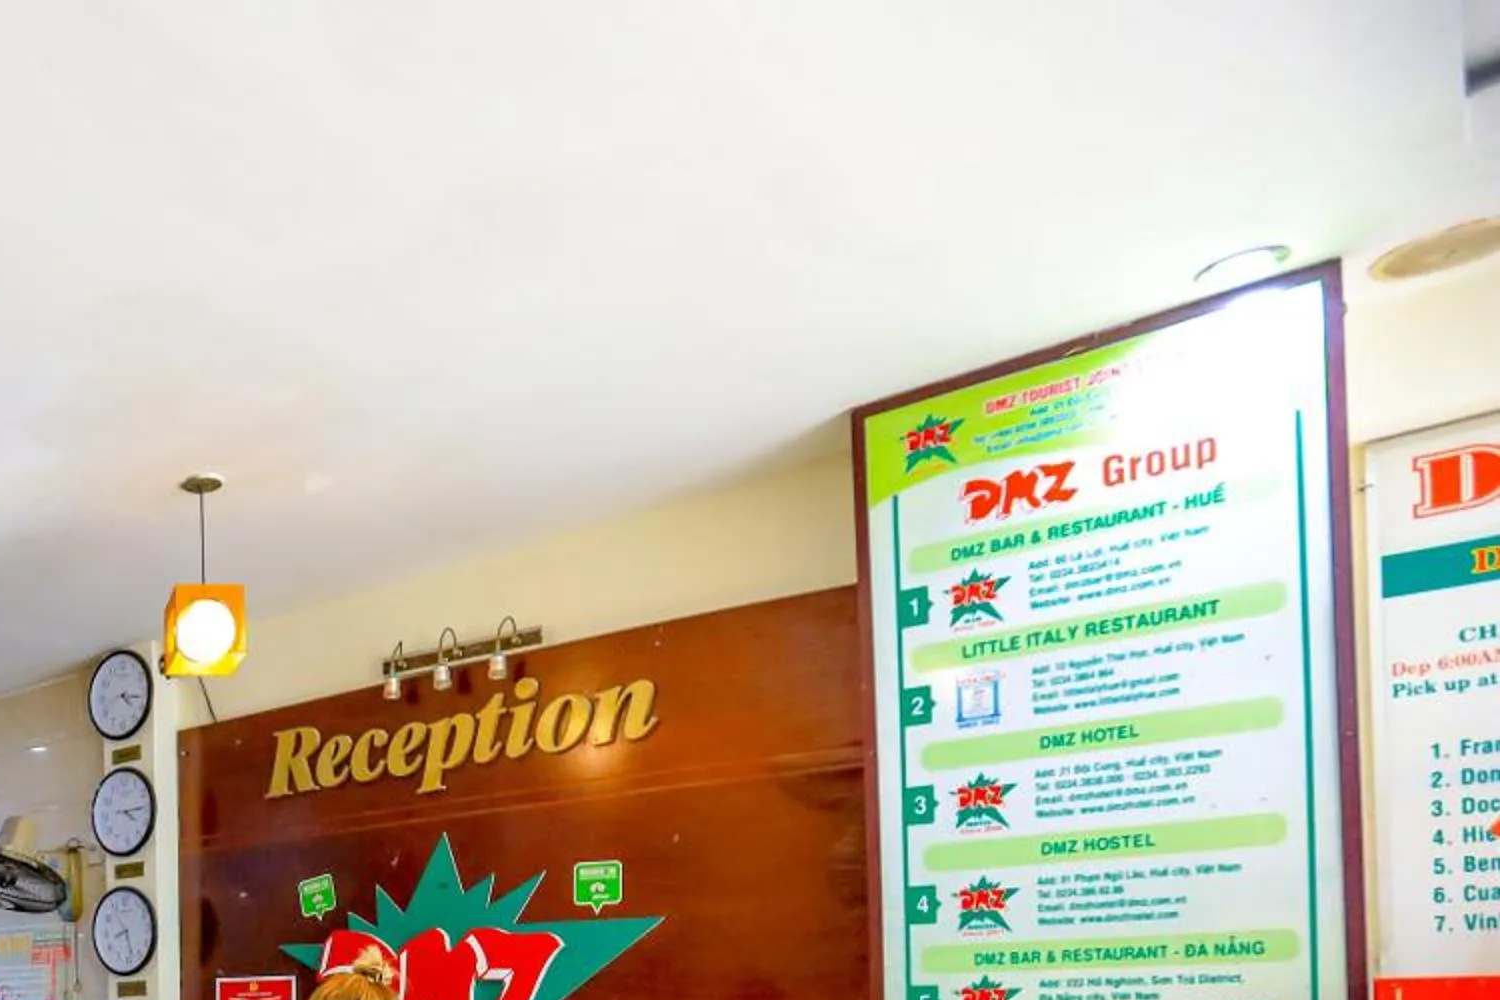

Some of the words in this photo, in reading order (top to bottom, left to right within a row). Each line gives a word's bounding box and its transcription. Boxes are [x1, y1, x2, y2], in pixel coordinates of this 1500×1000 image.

[907, 421, 950, 451] DMZ
[963, 460, 1079, 521] DMZ
[1102, 437, 1217, 488] Group
[951, 542, 984, 562] DMZ
[990, 532, 1024, 552] BAR
[1031, 529, 1041, 543] &
[1048, 501, 1165, 540] RESTAURANT
[951, 578, 996, 607] DMZ
[908, 598, 920, 618] 1
[962, 635, 1020, 660] LITTLE
[1027, 625, 1078, 647] ITALY
[1084, 599, 1220, 637] RESTAURANT
[1392, 661, 1431, 677] Dep
[1392, 680, 1437, 698] Pick
[1443, 678, 1471, 694] up
[1477, 672, 1498, 687] at
[910, 696, 926, 717] 2
[266, 676, 658, 799] Reception
[1039, 732, 1075, 749] DMZ
[1081, 723, 1139, 743] HOTEL
[1430, 741, 1451, 760] 1.
[1431, 771, 1452, 789] 2.
[913, 795, 927, 815] 3
[957, 782, 1003, 808] DMZ
[1431, 799, 1452, 817] 3.
[1041, 840, 1076, 856] DMZ
[1083, 832, 1155, 852] HOSTEL
[1432, 828, 1453, 846] 4.
[1433, 857, 1454, 875] 5.
[916, 895, 930, 914] 4
[960, 887, 1005, 911] DMZ
[1433, 886, 1454, 904] 6.
[1433, 915, 1455, 933] 7.
[974, 953, 1005, 966] DMZ
[1011, 951, 1040, 964] BAR
[1047, 951, 1055, 962] &
[1062, 944, 1167, 962] RESTAURANT
